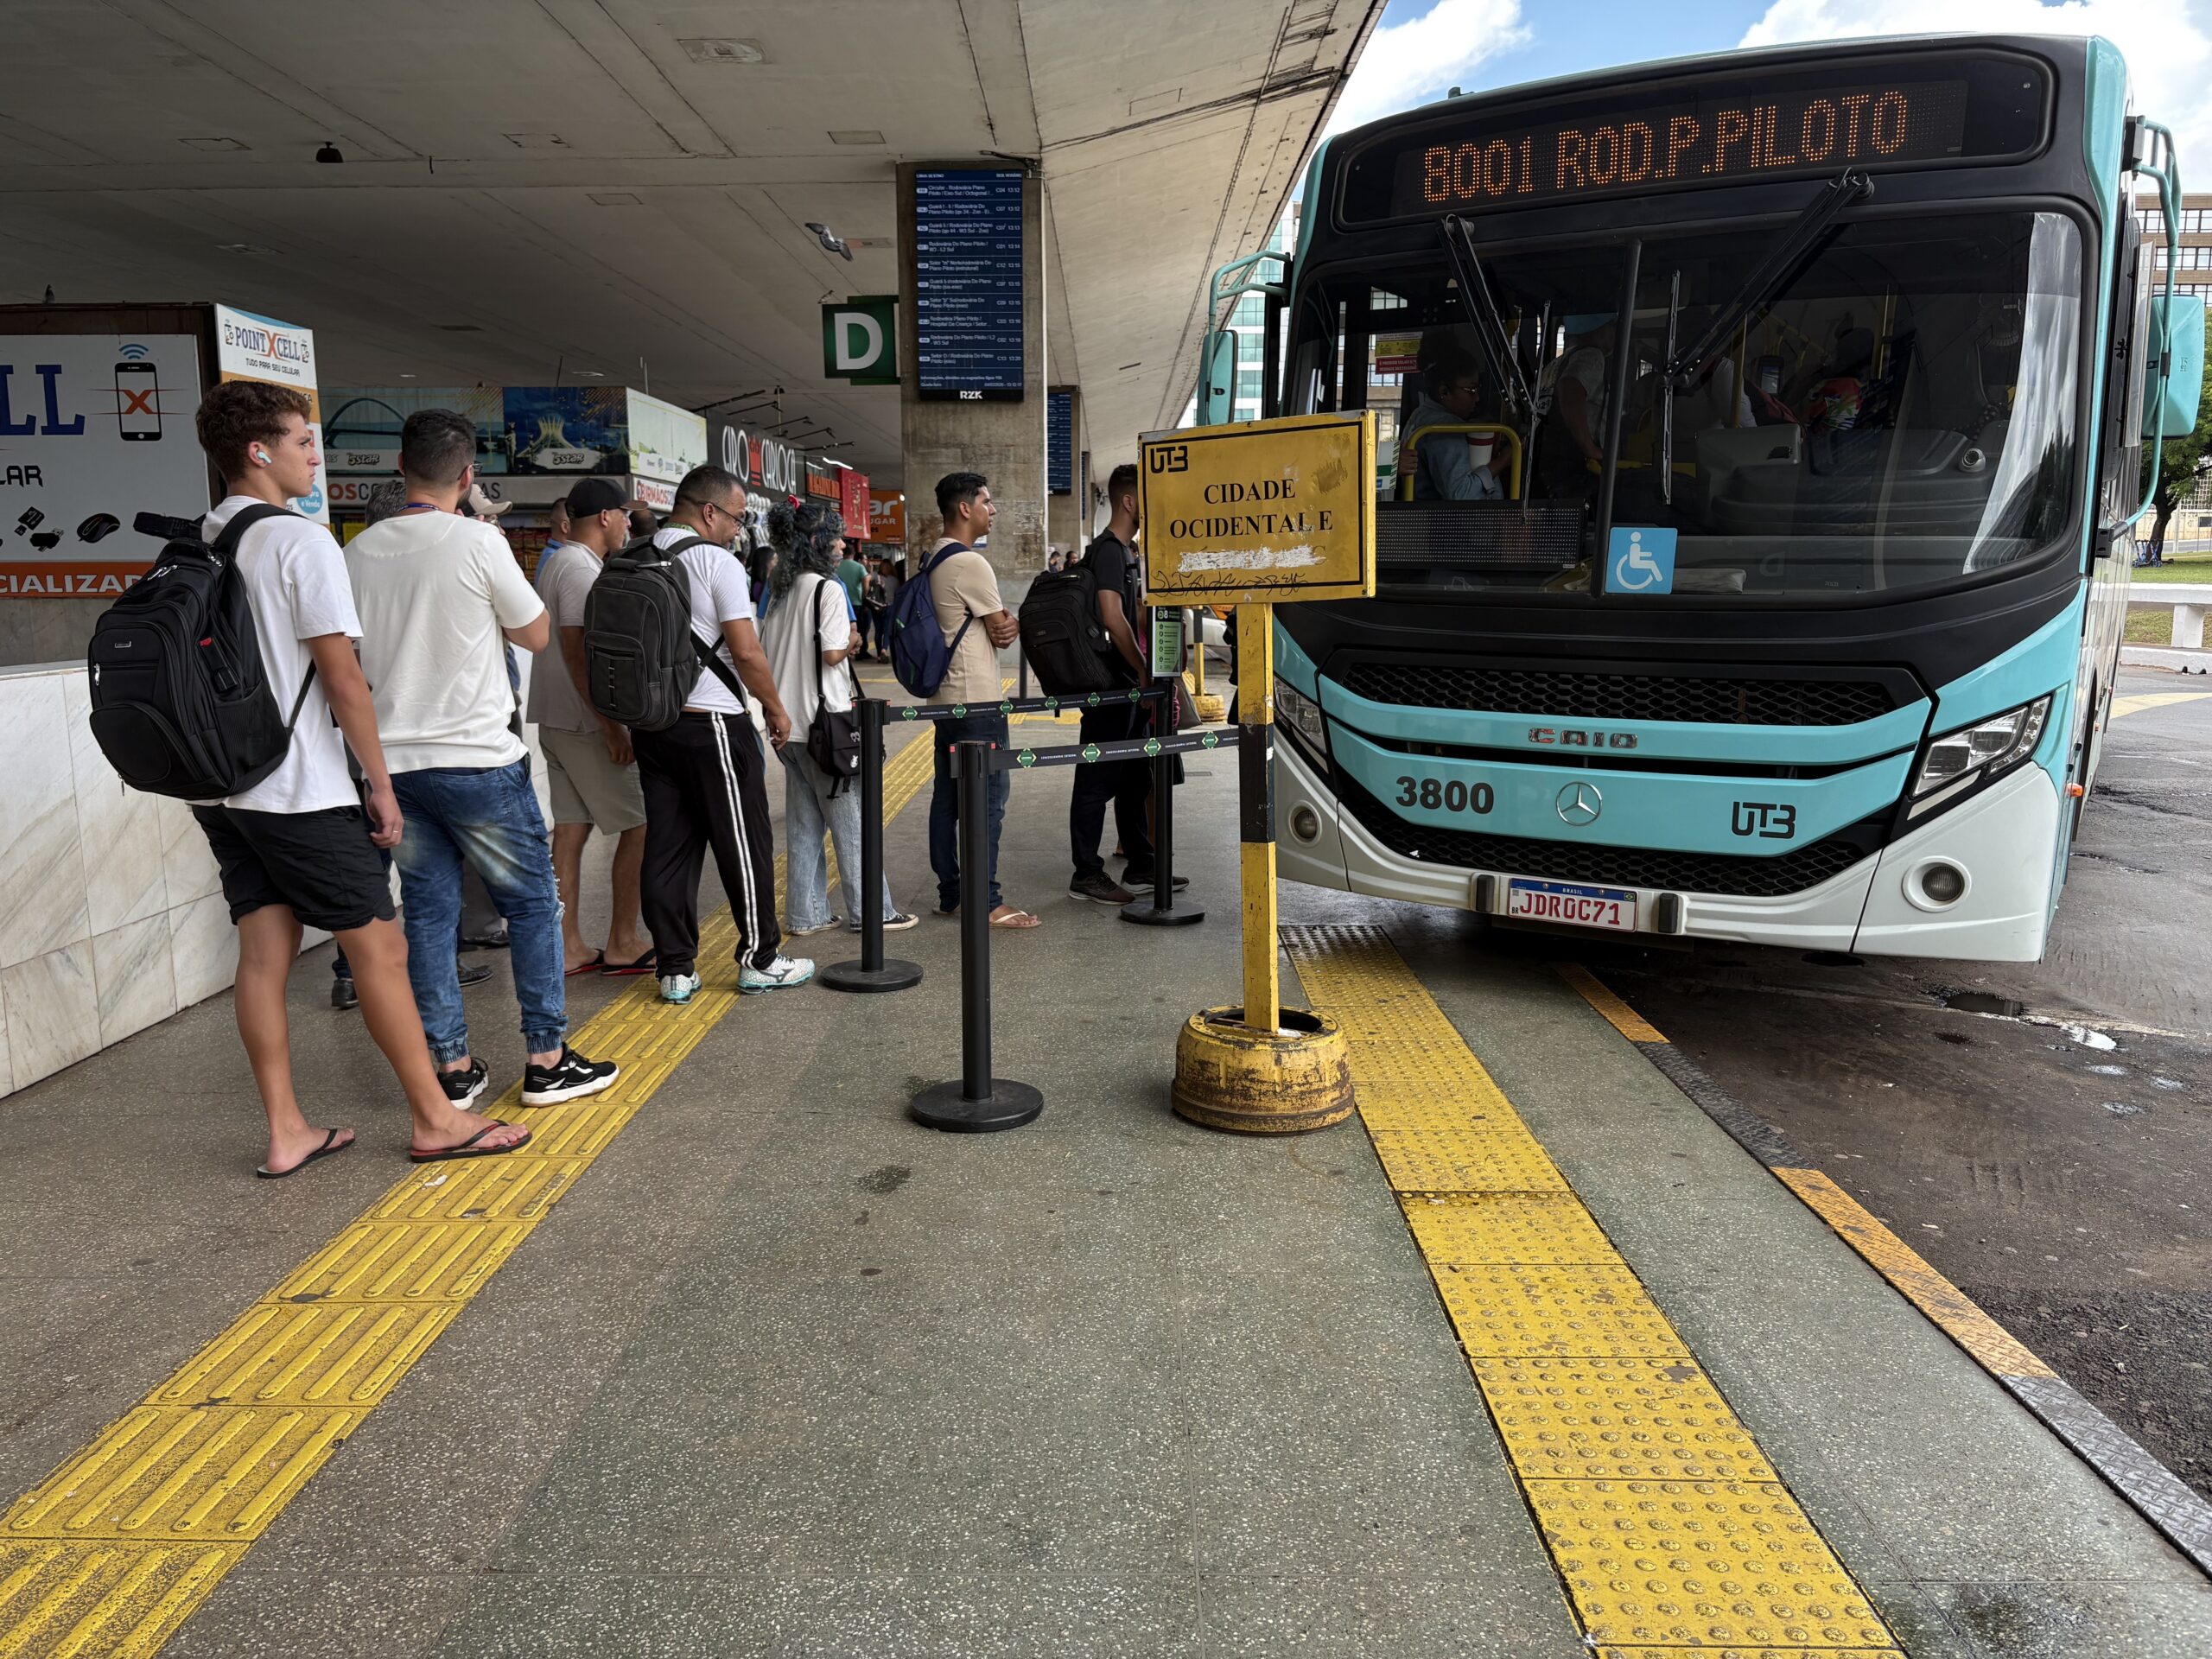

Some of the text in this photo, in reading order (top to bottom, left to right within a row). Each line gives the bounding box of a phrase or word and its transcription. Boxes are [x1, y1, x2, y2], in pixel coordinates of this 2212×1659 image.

[1423, 136, 1534, 202] 8001
[834, 312, 883, 371] D
[960, 391, 983, 399] RZK
[1204, 478, 1296, 505] CIDADE
[1528, 728, 1638, 749] CAIO
[1395, 775, 1494, 814] 3800
